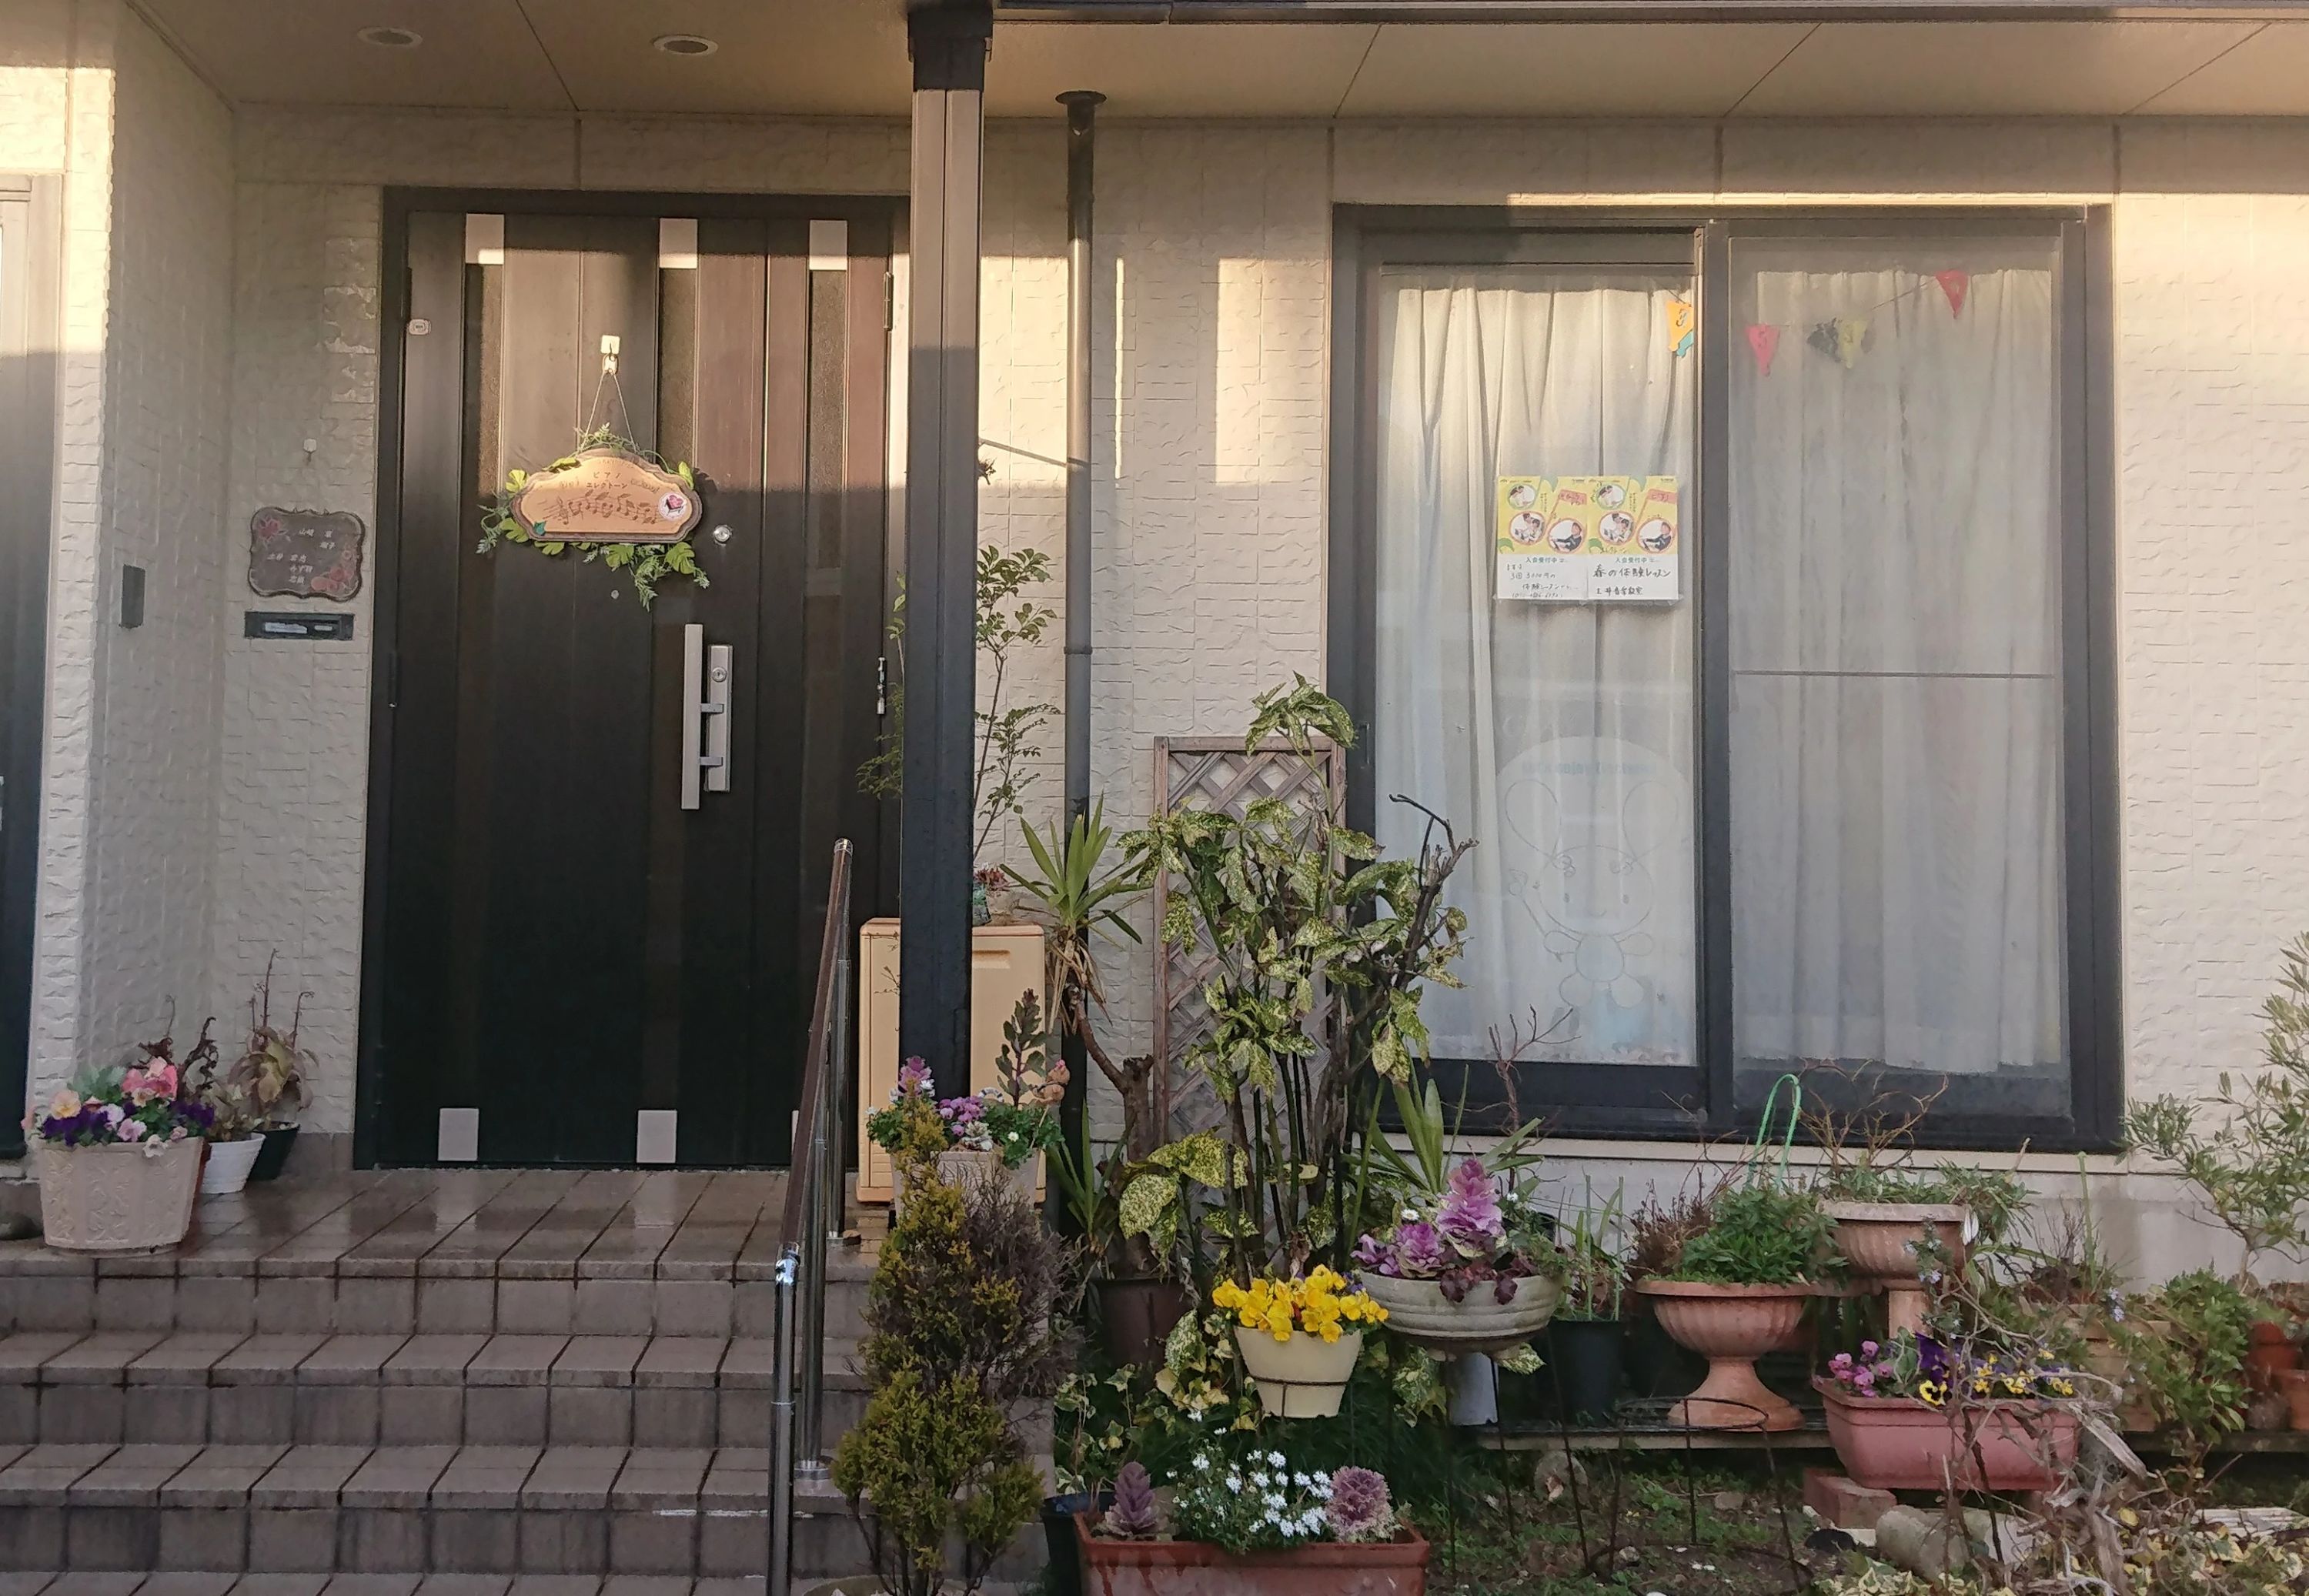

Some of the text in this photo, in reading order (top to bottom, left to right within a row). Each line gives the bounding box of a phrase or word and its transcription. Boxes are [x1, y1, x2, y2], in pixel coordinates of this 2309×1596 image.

[593, 471, 622, 479] ピアノ
[1592, 563, 1671, 578] 春の体験レッスン
